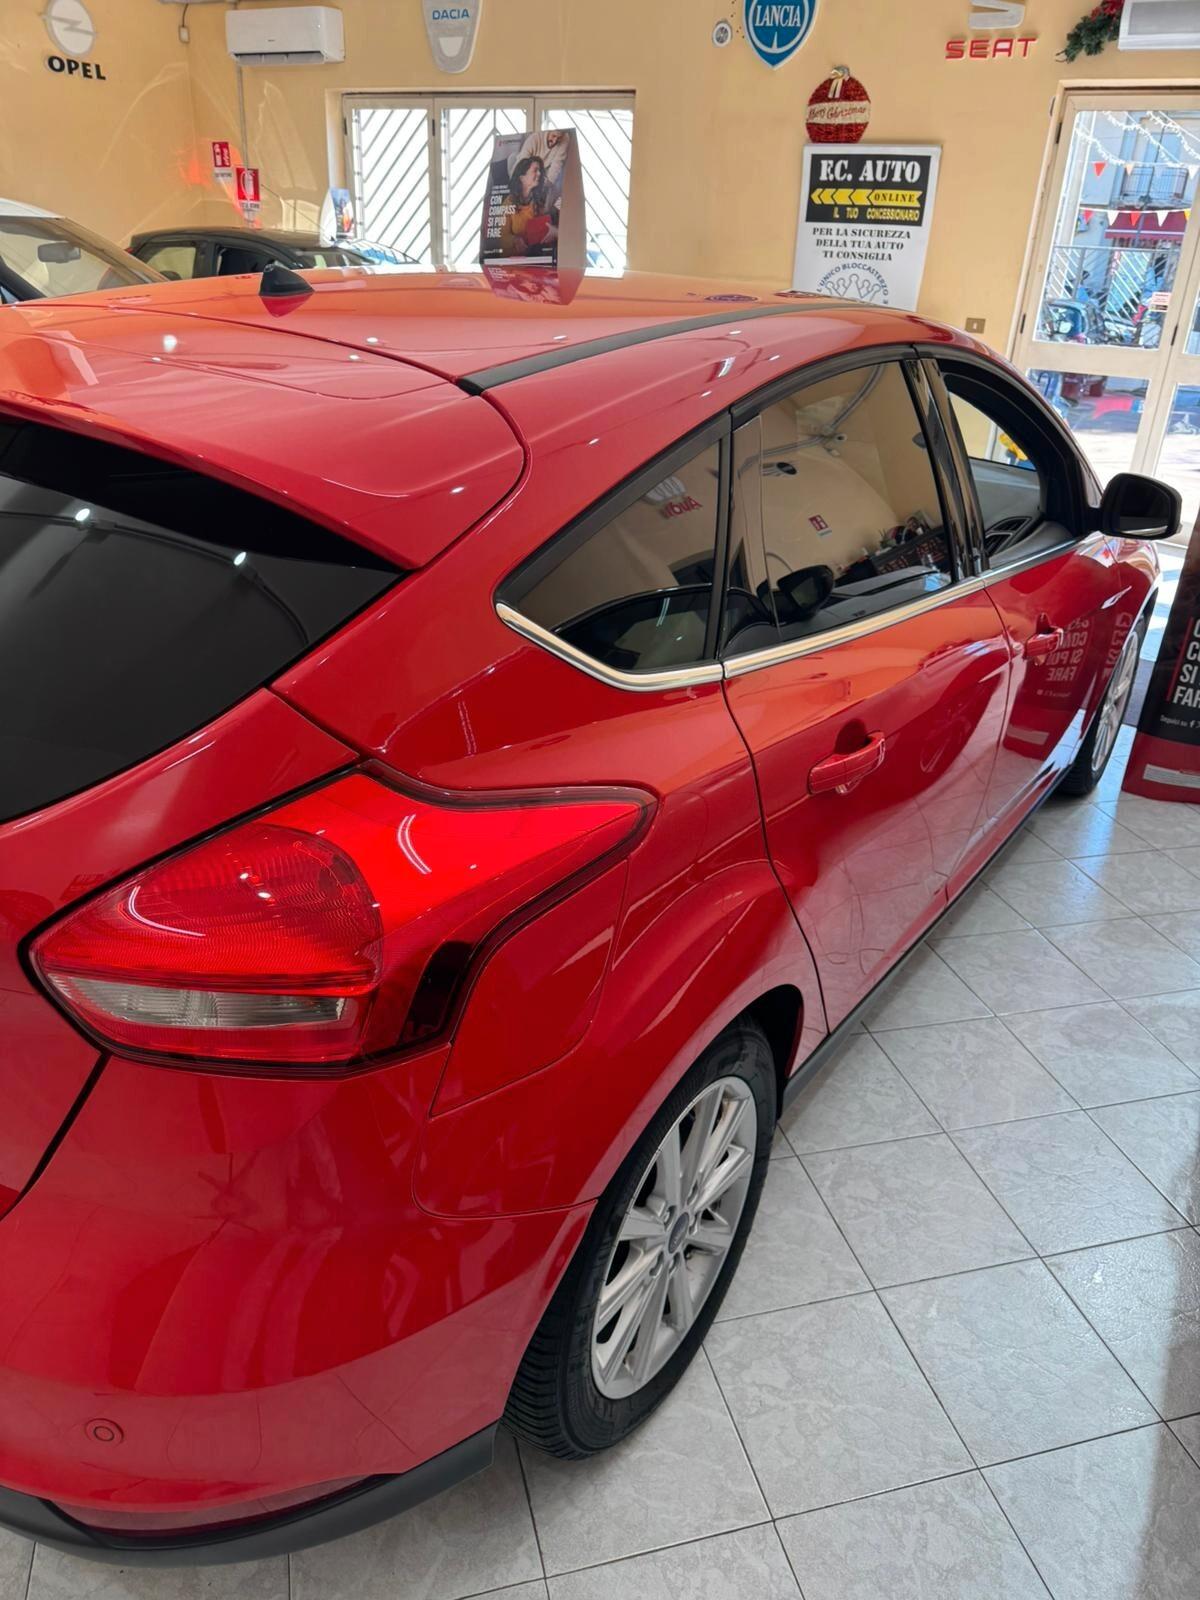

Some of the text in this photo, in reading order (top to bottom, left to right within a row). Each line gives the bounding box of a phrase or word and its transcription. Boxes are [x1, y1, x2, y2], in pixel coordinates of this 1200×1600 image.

[432, 8, 470, 20] DACIA
[755, 5, 801, 27] LANCIA
[945, 38, 1037, 59] SEAT
[48, 55, 106, 80] OPEL
[859, 159, 921, 183] AUTO
[490, 195, 503, 205] CON
[874, 191, 916, 203] ONLINE
[489, 204, 516, 216] COMPASS
[833, 207, 920, 221] IL TUO CONCESSIONARIO
[487, 227, 502, 238] FARE
[812, 227, 911, 239] PER LA SICUREZZA
[816, 239, 904, 250] DELLA TUA AUTO
[822, 250, 892, 261] TI CONSIGLIA
[1180, 664, 1198, 684] SI
